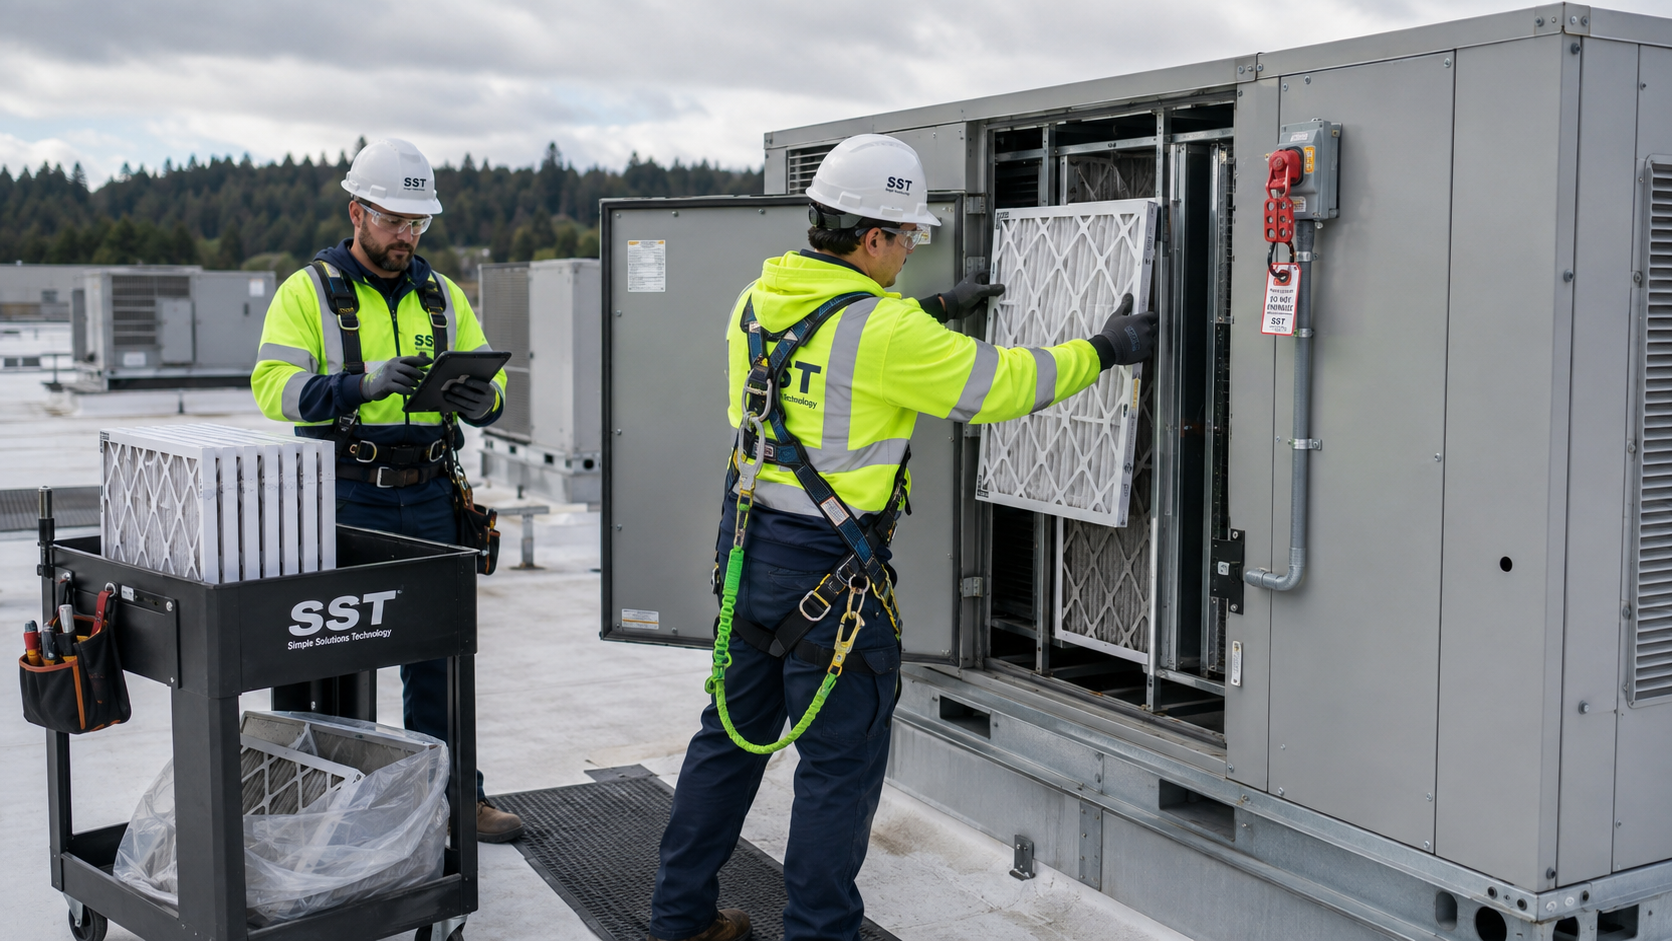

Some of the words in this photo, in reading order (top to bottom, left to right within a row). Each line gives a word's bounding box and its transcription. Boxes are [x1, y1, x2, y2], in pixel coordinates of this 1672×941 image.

[403, 177, 427, 188] SST
[887, 176, 912, 191] SST
[1271, 317, 1285, 325] SST
[414, 334, 434, 347] SS
[780, 360, 822, 394] ST
[288, 590, 397, 636] SST
[287, 640, 313, 650] Simple
[315, 635, 350, 646] Solutions
[351, 629, 392, 641] Technology
